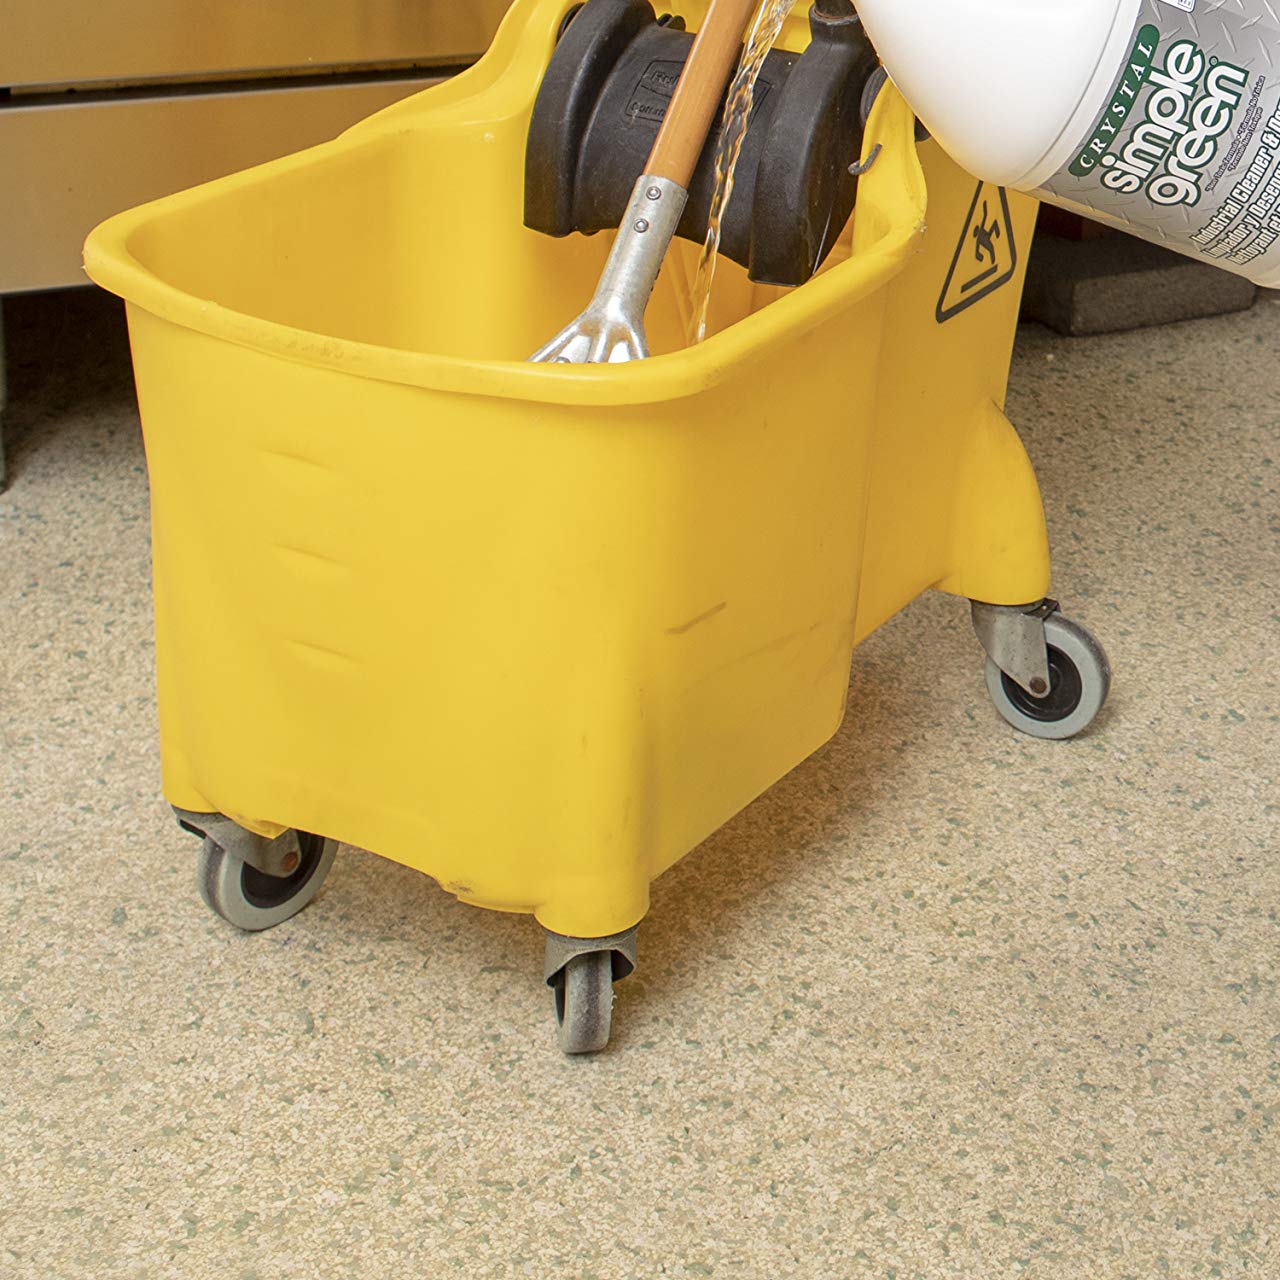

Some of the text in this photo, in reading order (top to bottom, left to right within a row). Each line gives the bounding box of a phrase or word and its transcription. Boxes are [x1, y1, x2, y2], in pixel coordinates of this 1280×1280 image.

[1079, 41, 1153, 169] CRYSTAL
[1101, 39, 1205, 194] simple
[1145, 61, 1250, 208] green
[1222, 139, 1240, 165] Formula
[1189, 198, 1243, 246] Industrial
[1231, 146, 1274, 204] Cleaner
[1261, 128, 1280, 150] &
[1201, 221, 1253, 259] Limpiador
[1244, 214, 1261, 230] y
[1226, 226, 1278, 266] Nettoyant
